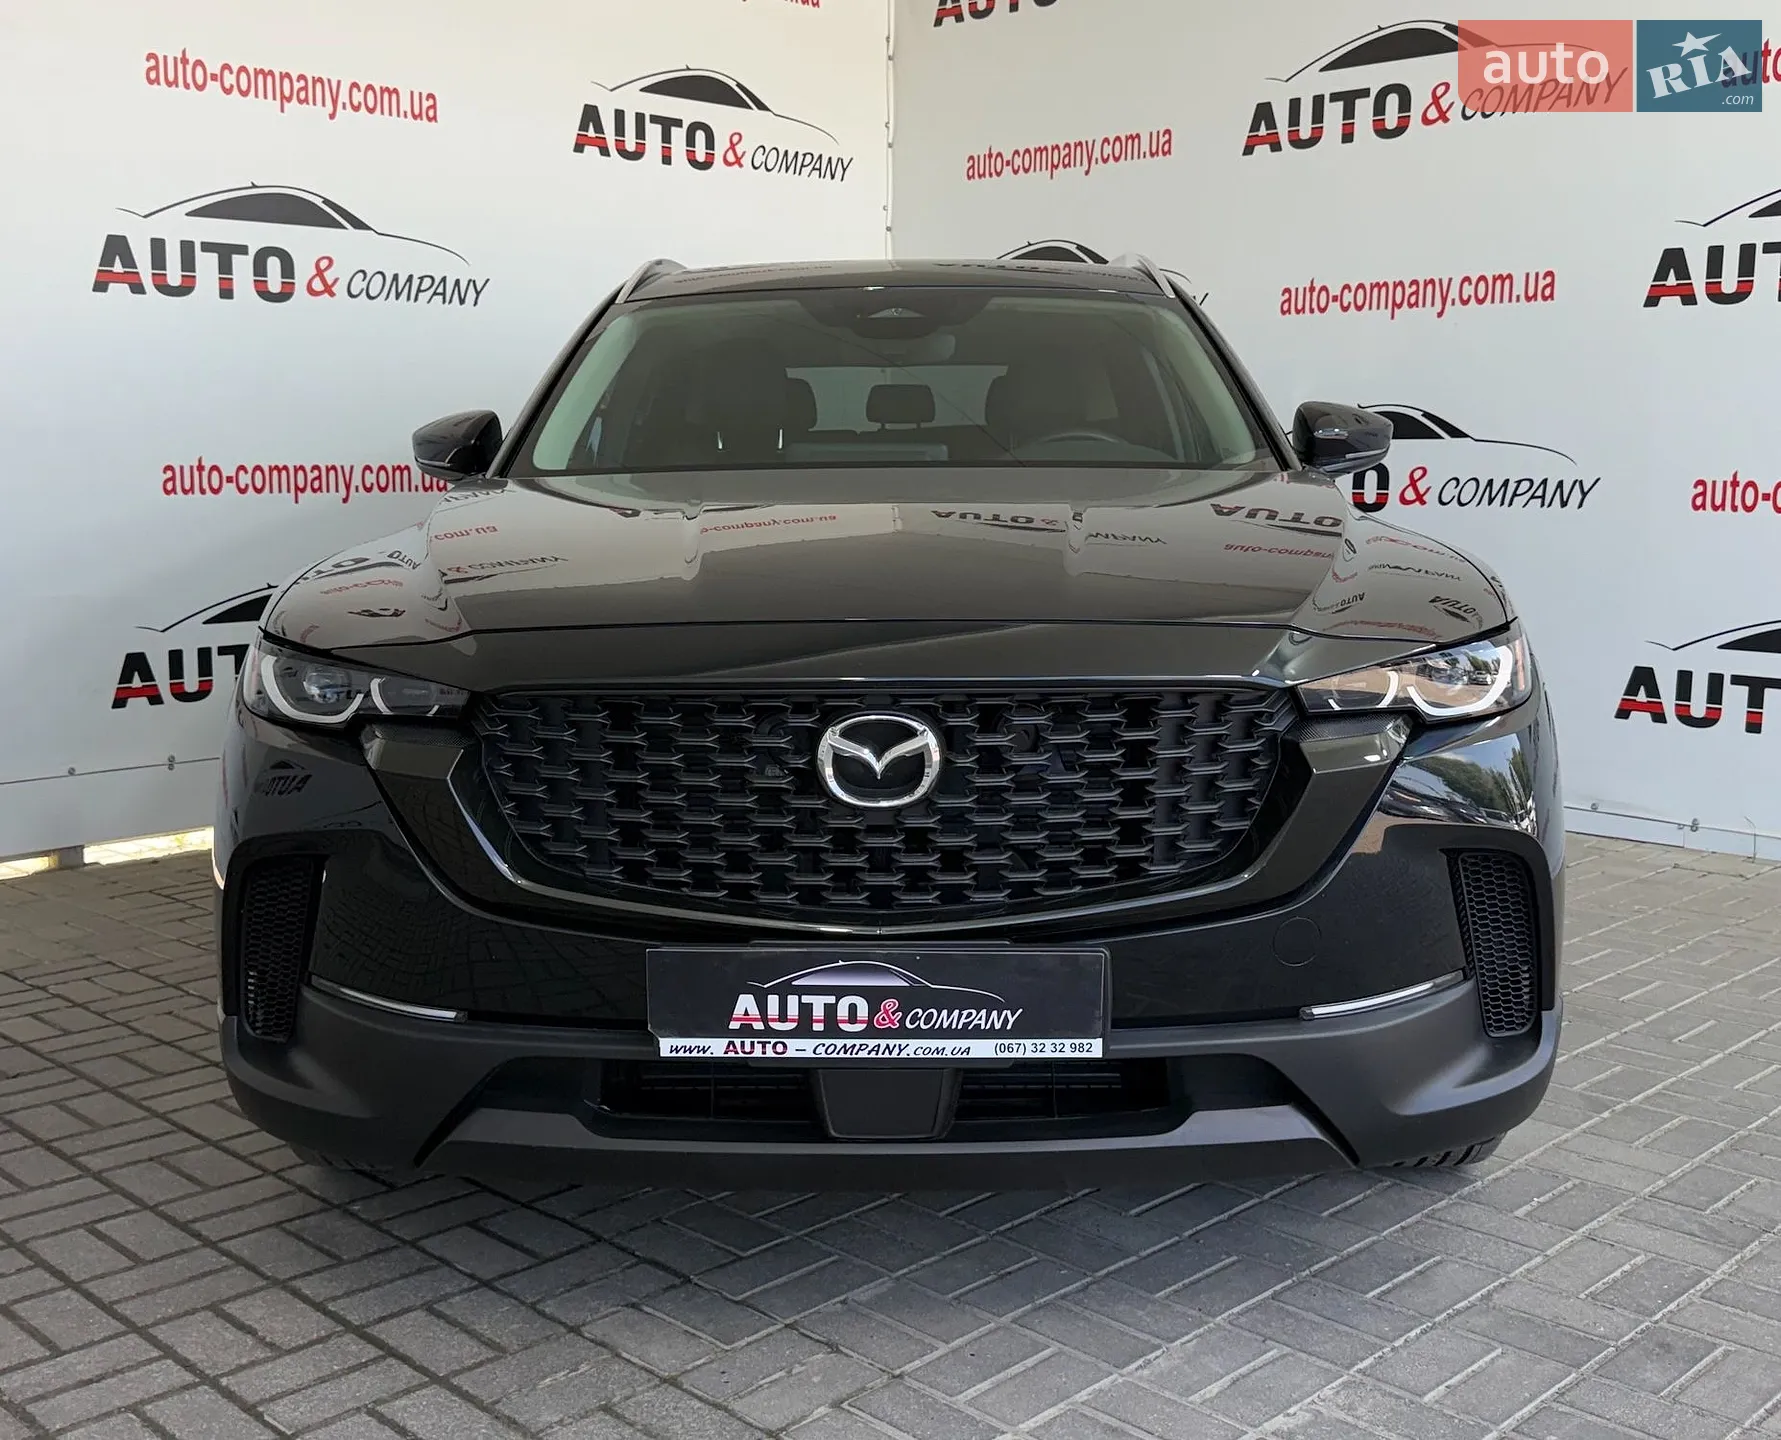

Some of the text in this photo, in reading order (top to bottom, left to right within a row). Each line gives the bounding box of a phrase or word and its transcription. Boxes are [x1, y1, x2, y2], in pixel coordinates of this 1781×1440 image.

[145, 48, 438, 123] auto-company.com.ua
[1242, 67, 1628, 156] AUTO & COMPANY
[573, 103, 853, 182] AUTO & COMPANY
[966, 127, 1172, 180] auto-company.com.ua
[92, 234, 490, 307] AUTO & COMPANY
[1280, 270, 1556, 319] auto-company.com.ua
[1399, 466, 1431, 505] &
[1438, 477, 1600, 510] COMPANY
[728, 994, 1023, 1032] AUTO & COMPANY
[723, 1040, 788, 1056] AUTO
[994, 1042, 1026, 1056] (067)
[1031, 1043, 1046, 1053] 32
[1050, 1043, 1066, 1053] 32
[1069, 1043, 1093, 1053] 982
